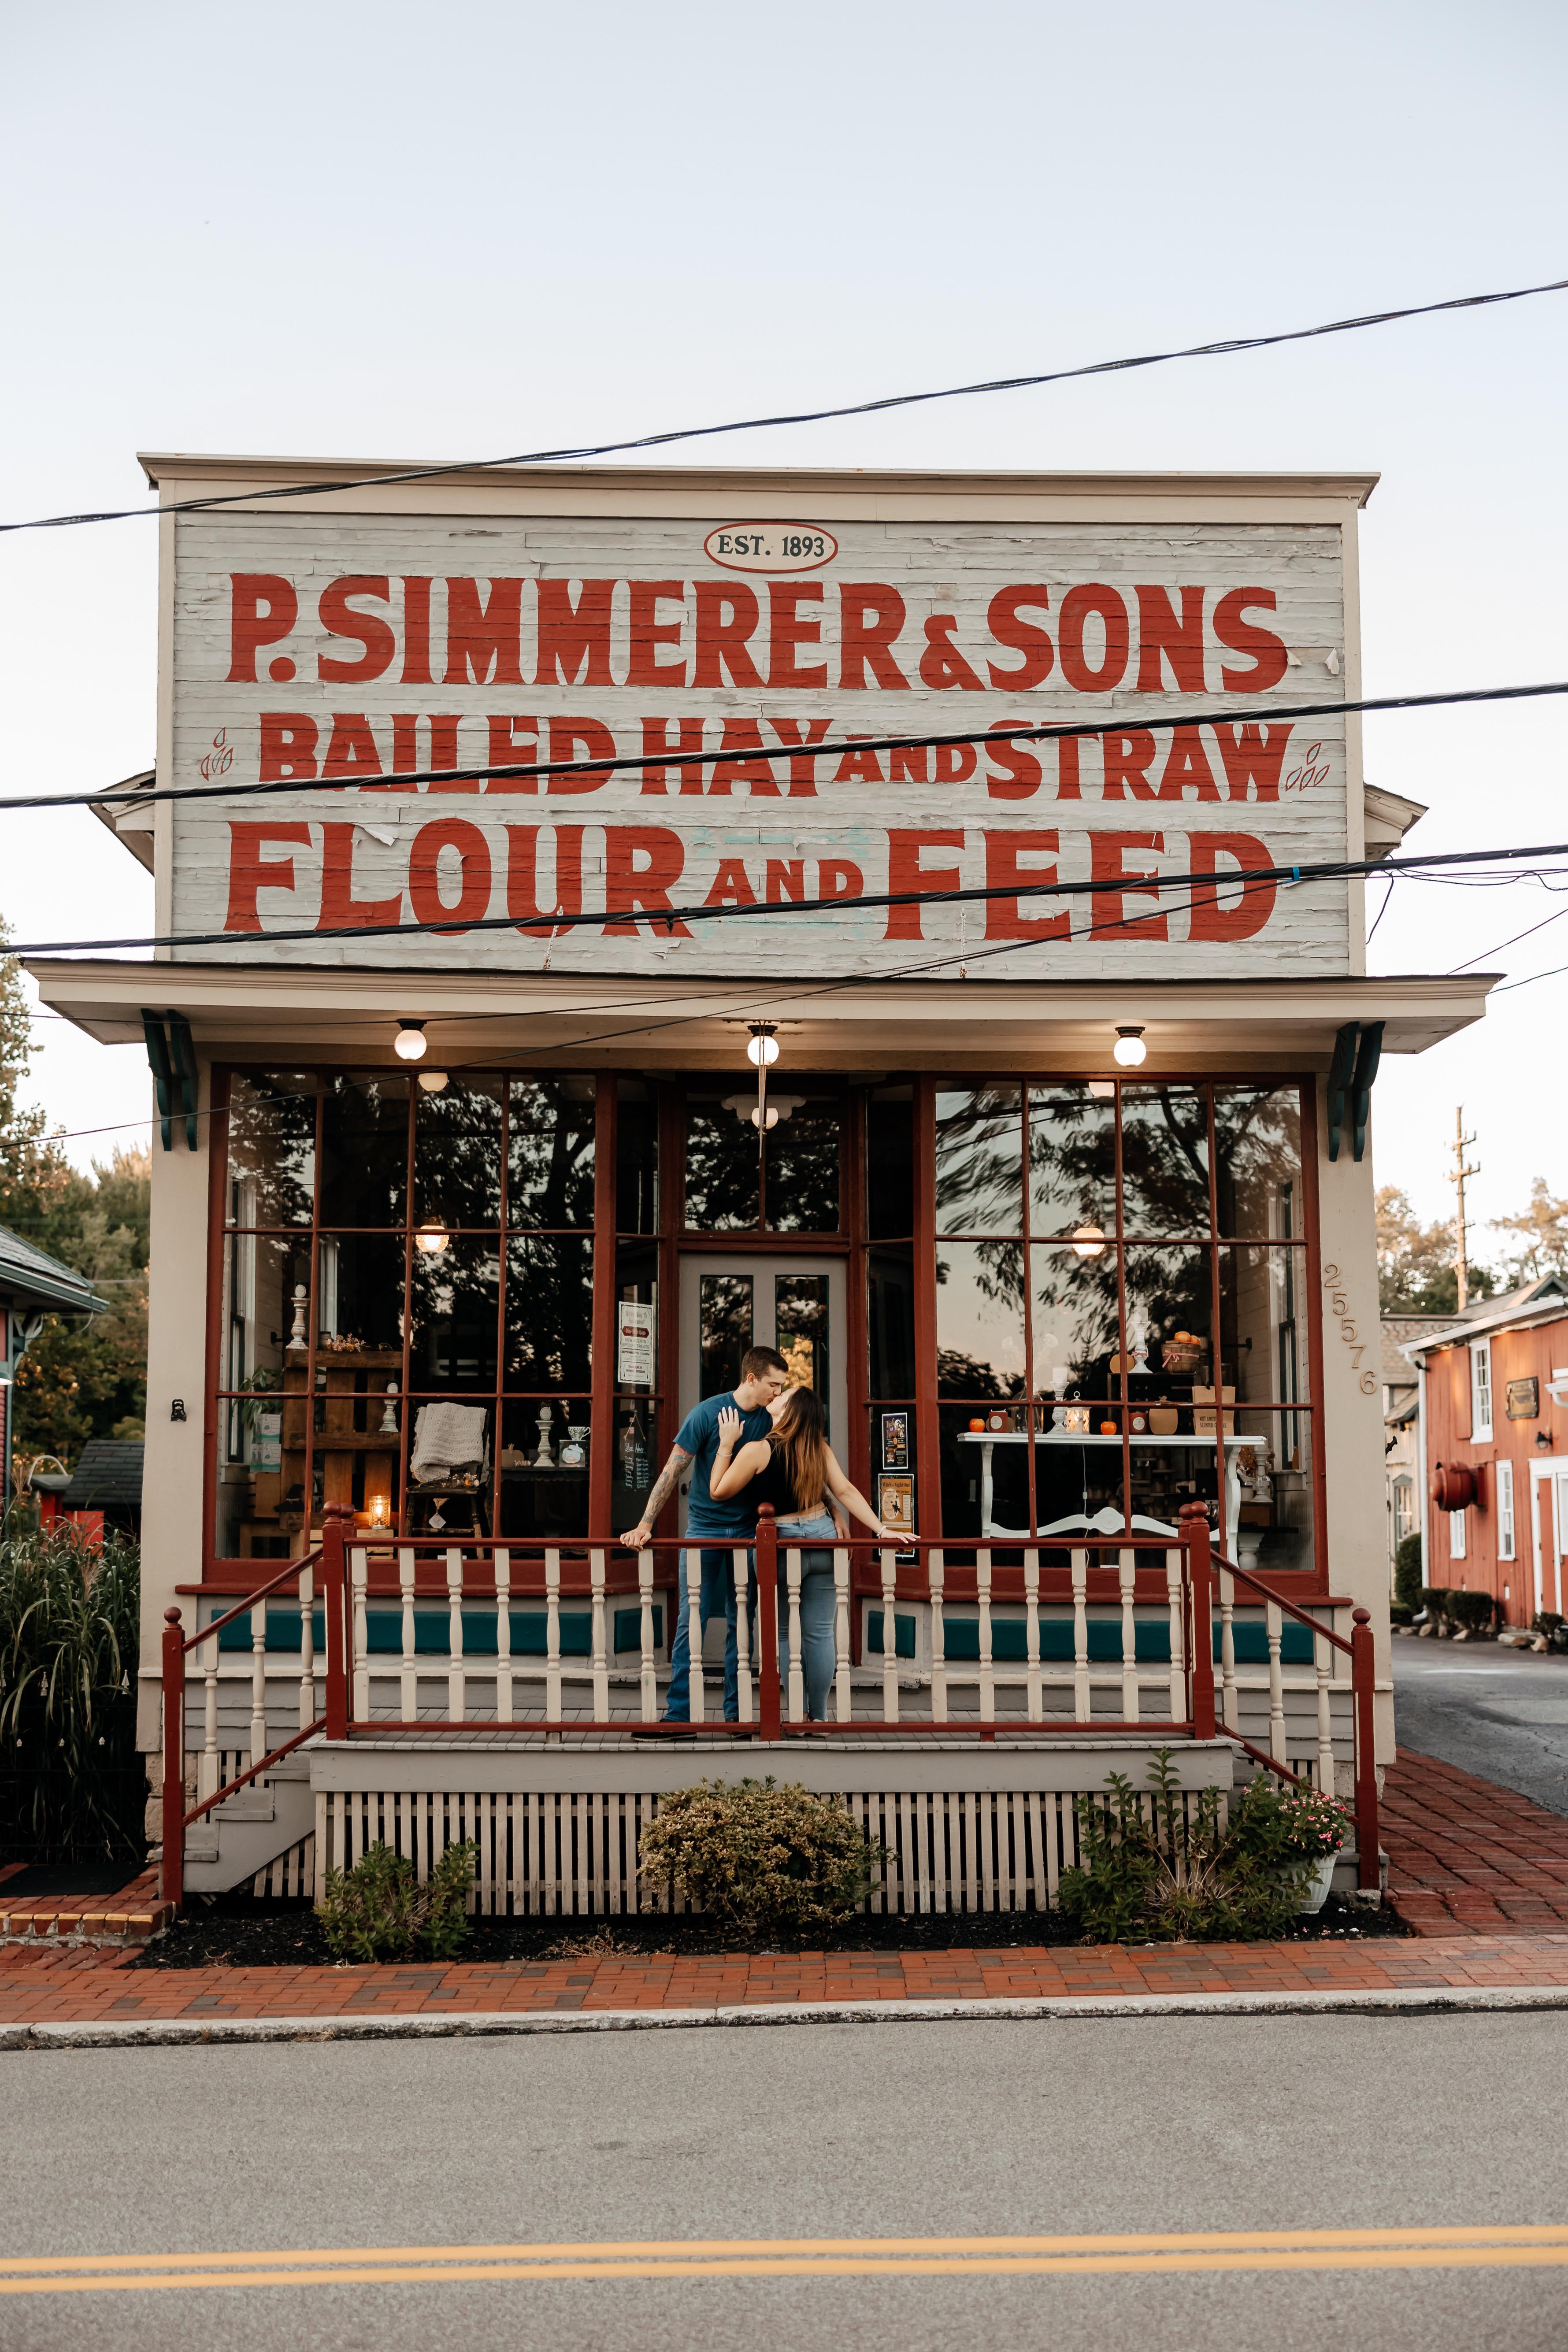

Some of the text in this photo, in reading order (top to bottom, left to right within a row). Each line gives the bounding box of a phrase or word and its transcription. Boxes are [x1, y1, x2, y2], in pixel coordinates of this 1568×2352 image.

[717, 534, 824, 557] EST. 1893
[987, 583, 1287, 693] SONS
[259, 713, 1295, 802] BAILED HAY AND STRAW
[223, 818, 1276, 942] FLOUR AND FEED
